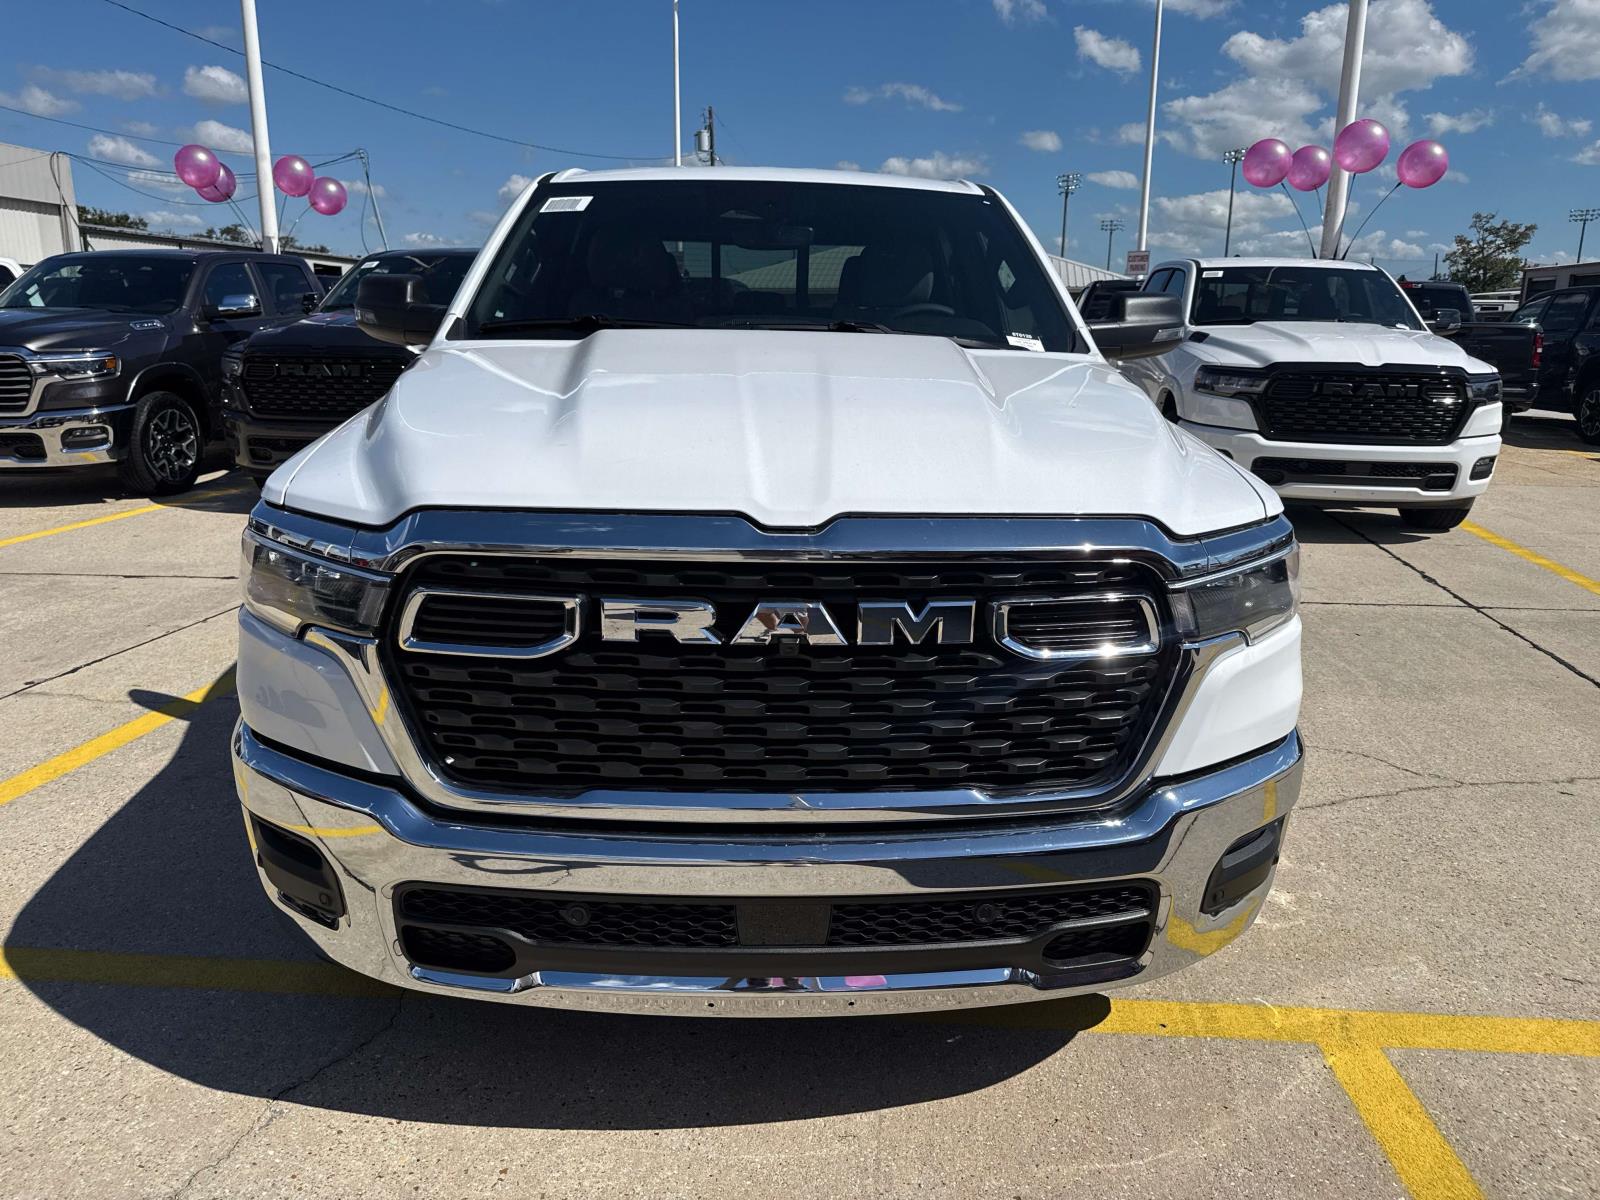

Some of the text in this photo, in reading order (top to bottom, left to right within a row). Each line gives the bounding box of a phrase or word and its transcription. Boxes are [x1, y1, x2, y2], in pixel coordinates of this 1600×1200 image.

[280, 364, 361, 377] RAM
[1322, 382, 1420, 397] RAM
[600, 599, 977, 646] RAM
